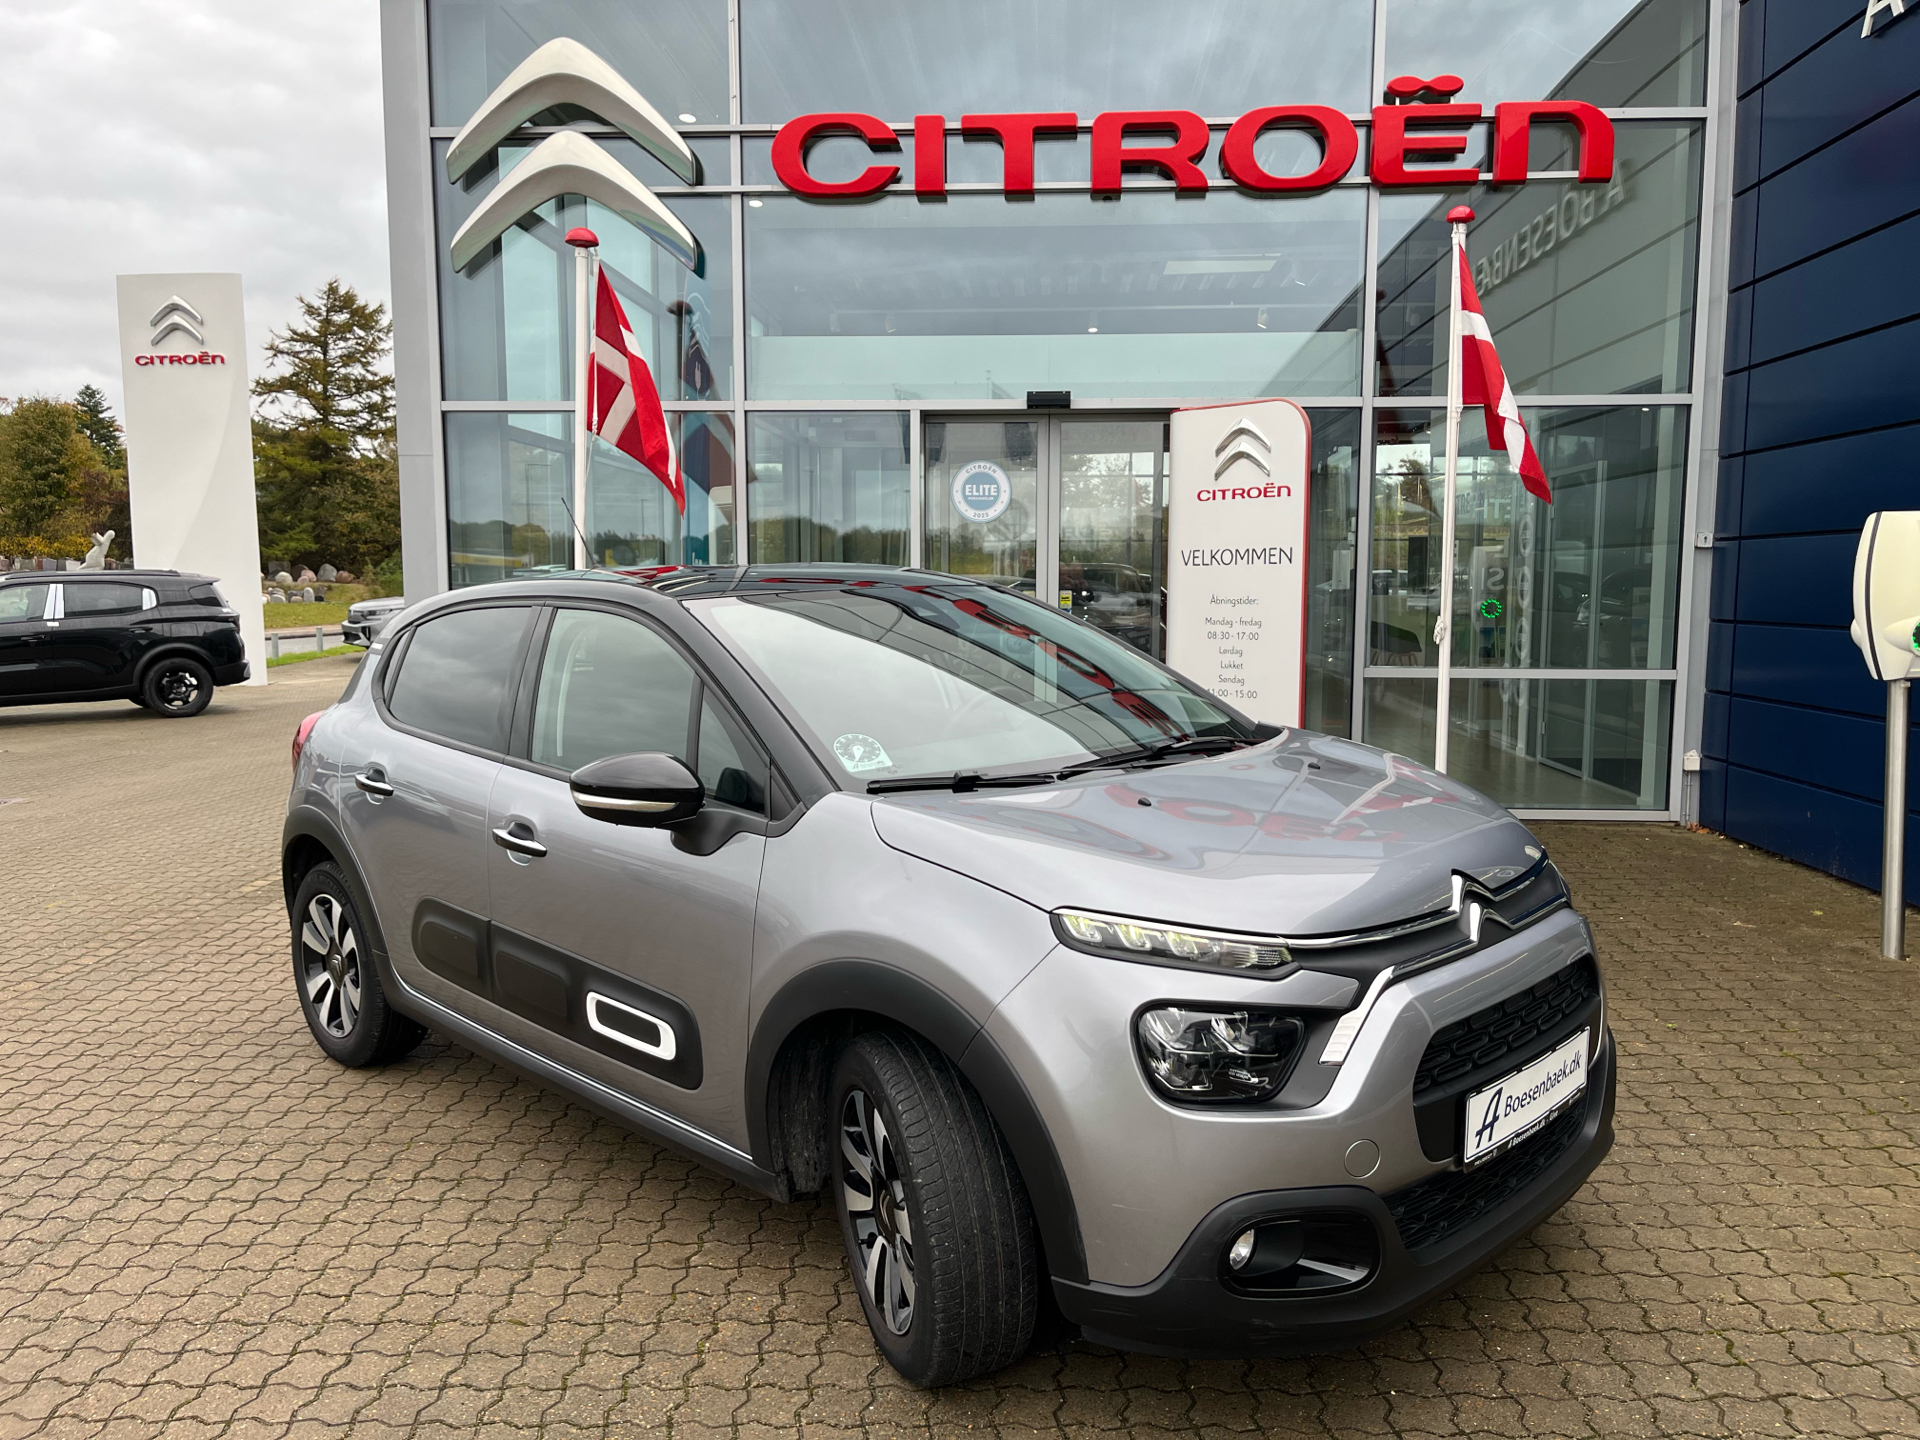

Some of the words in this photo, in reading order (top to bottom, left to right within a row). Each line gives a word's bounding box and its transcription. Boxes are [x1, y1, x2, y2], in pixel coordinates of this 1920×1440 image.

[771, 75, 1614, 200] CITROËN
[134, 351, 226, 366] CITROËN
[965, 464, 997, 474] CITROËN
[965, 484, 998, 496] ELITE
[1196, 482, 1292, 502] CITROËN
[1181, 546, 1293, 567] VELKOMMEN
[1210, 594, 1259, 607] Åbningstider:
[1205, 616, 1233, 628] Mandag
[1239, 616, 1262, 629] fredag
[1207, 631, 1230, 640] 08:30
[1237, 631, 1259, 640] 17:00
[1219, 646, 1243, 657] Lørdag
[1220, 660, 1243, 669] Lukket
[1218, 674, 1245, 686] Søndag
[1235, 690, 1258, 699] 15:00
[1475, 1086, 1503, 1149] A
[1504, 1050, 1582, 1118] Boesenbaek.dk
